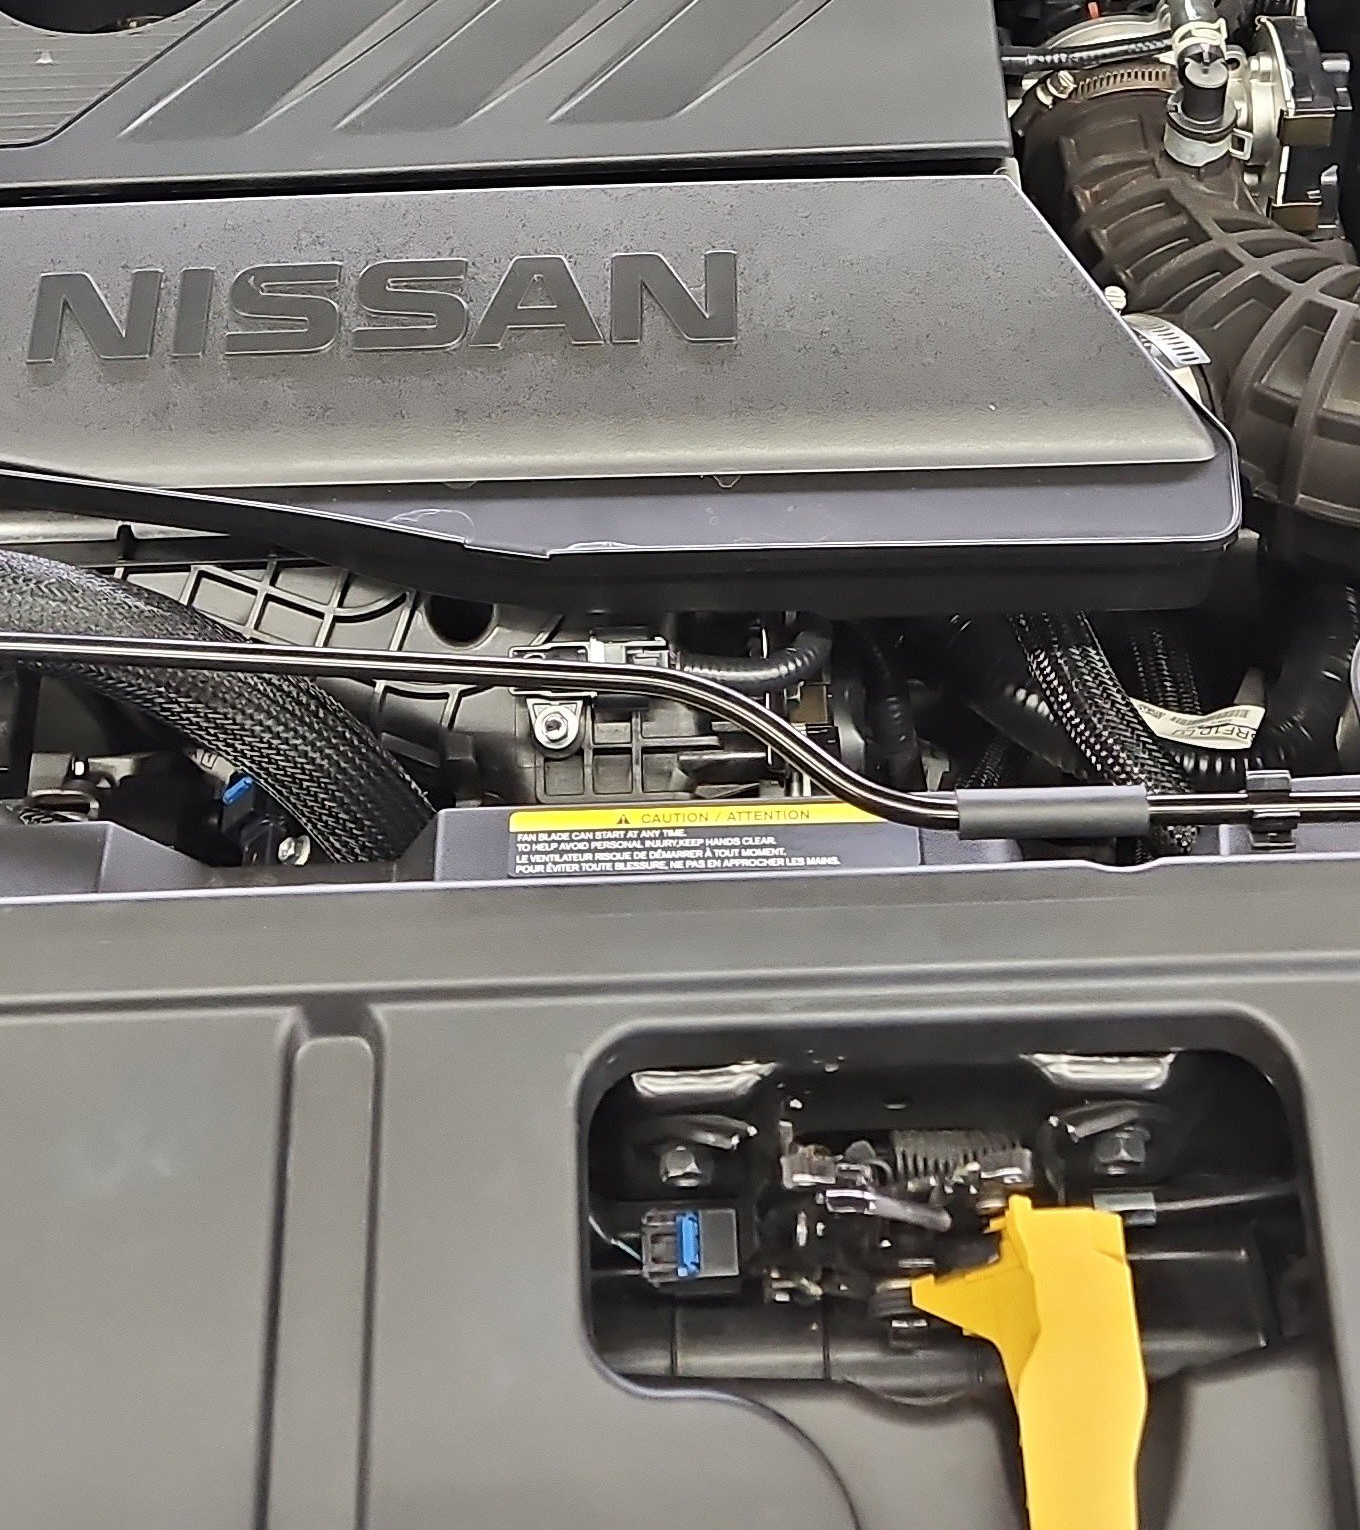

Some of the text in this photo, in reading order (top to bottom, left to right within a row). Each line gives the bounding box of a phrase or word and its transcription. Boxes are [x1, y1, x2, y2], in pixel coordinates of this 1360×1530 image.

[25, 249, 738, 365] NISSAN
[641, 812, 709, 824] CAUTION
[727, 809, 810, 821] ATTENTION
[517, 828, 687, 842] FAN BLADE CAN START AT ANY TIME.
[516, 843, 531, 852] TO
[532, 842, 559, 852] HELP
[559, 841, 590, 851] AVOID
[590, 840, 644, 849] PERSONAL
[705, 837, 741, 847] HANDS
[742, 836, 777, 846] CLEAR.
[516, 847, 787, 864] LE VENTILATEUR RISQUE DE DÉMARRER À TOUT MOMENT.
[516, 864, 545, 874] POUR
[545, 862, 579, 873] ÉVITER
[579, 862, 614, 872] TOUTE
[669, 860, 684, 869] NE
[685, 859, 706, 869] PAS
[706, 858, 721, 868] EN
[722, 857, 785, 868] APPROCHER
[786, 857, 805, 867] LES
[806, 856, 841, 866] MAINS.
